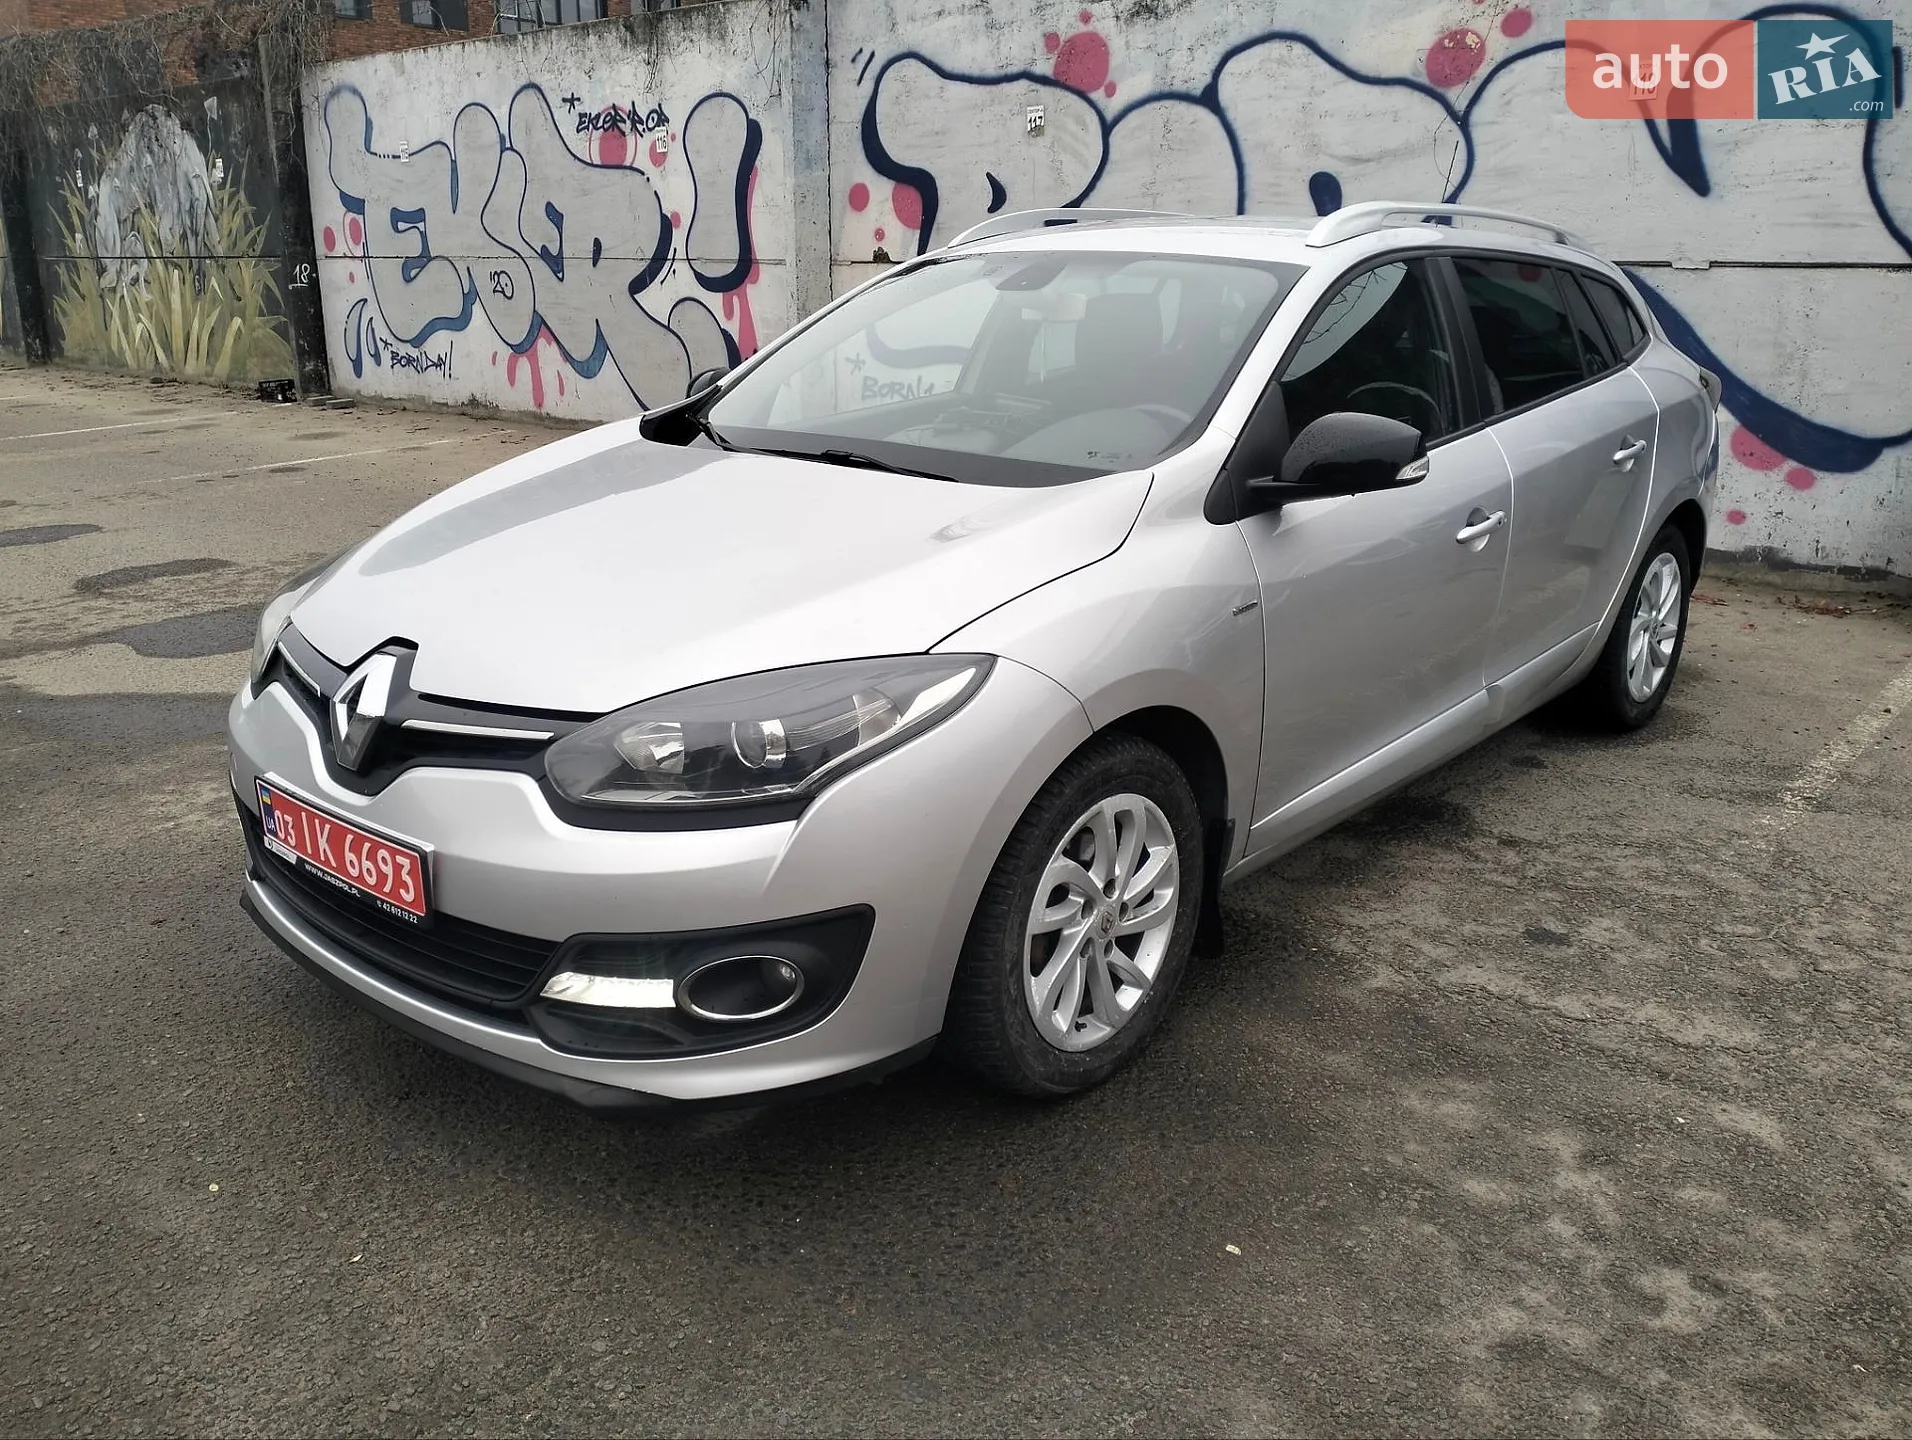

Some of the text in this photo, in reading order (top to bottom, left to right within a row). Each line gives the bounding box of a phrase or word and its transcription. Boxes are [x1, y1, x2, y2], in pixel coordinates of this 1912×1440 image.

[1028, 115, 1043, 131] 117
[656, 134, 667, 149] 116
[293, 263, 311, 284] 18
[266, 815, 276, 832] UA
[274, 810, 415, 902] 03 IK 6693
